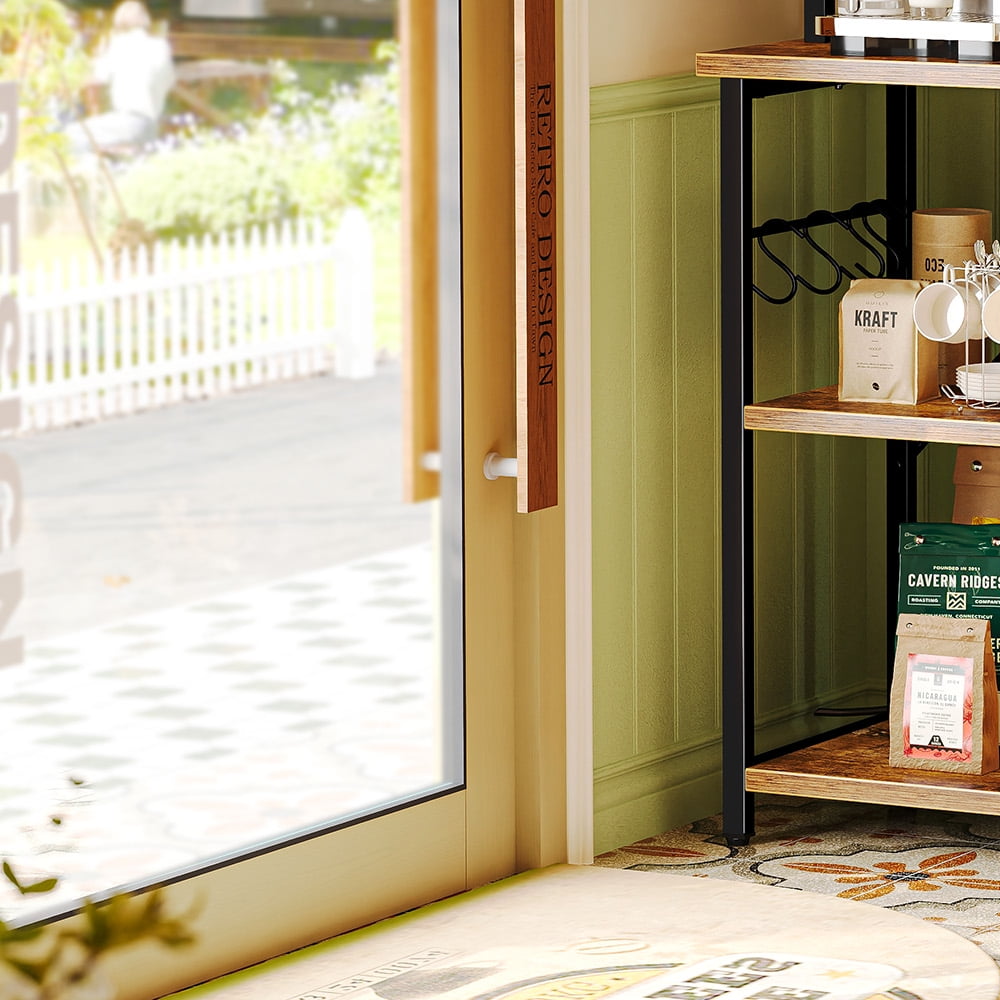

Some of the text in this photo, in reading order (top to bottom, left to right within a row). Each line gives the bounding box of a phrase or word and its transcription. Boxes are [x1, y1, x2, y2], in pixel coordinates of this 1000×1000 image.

[537, 82, 554, 388] RETRO DESIGN
[855, 310, 898, 328] KRAFT
[908, 573, 957, 588] CAVERN
[917, 691, 957, 702] NICARAGUA
